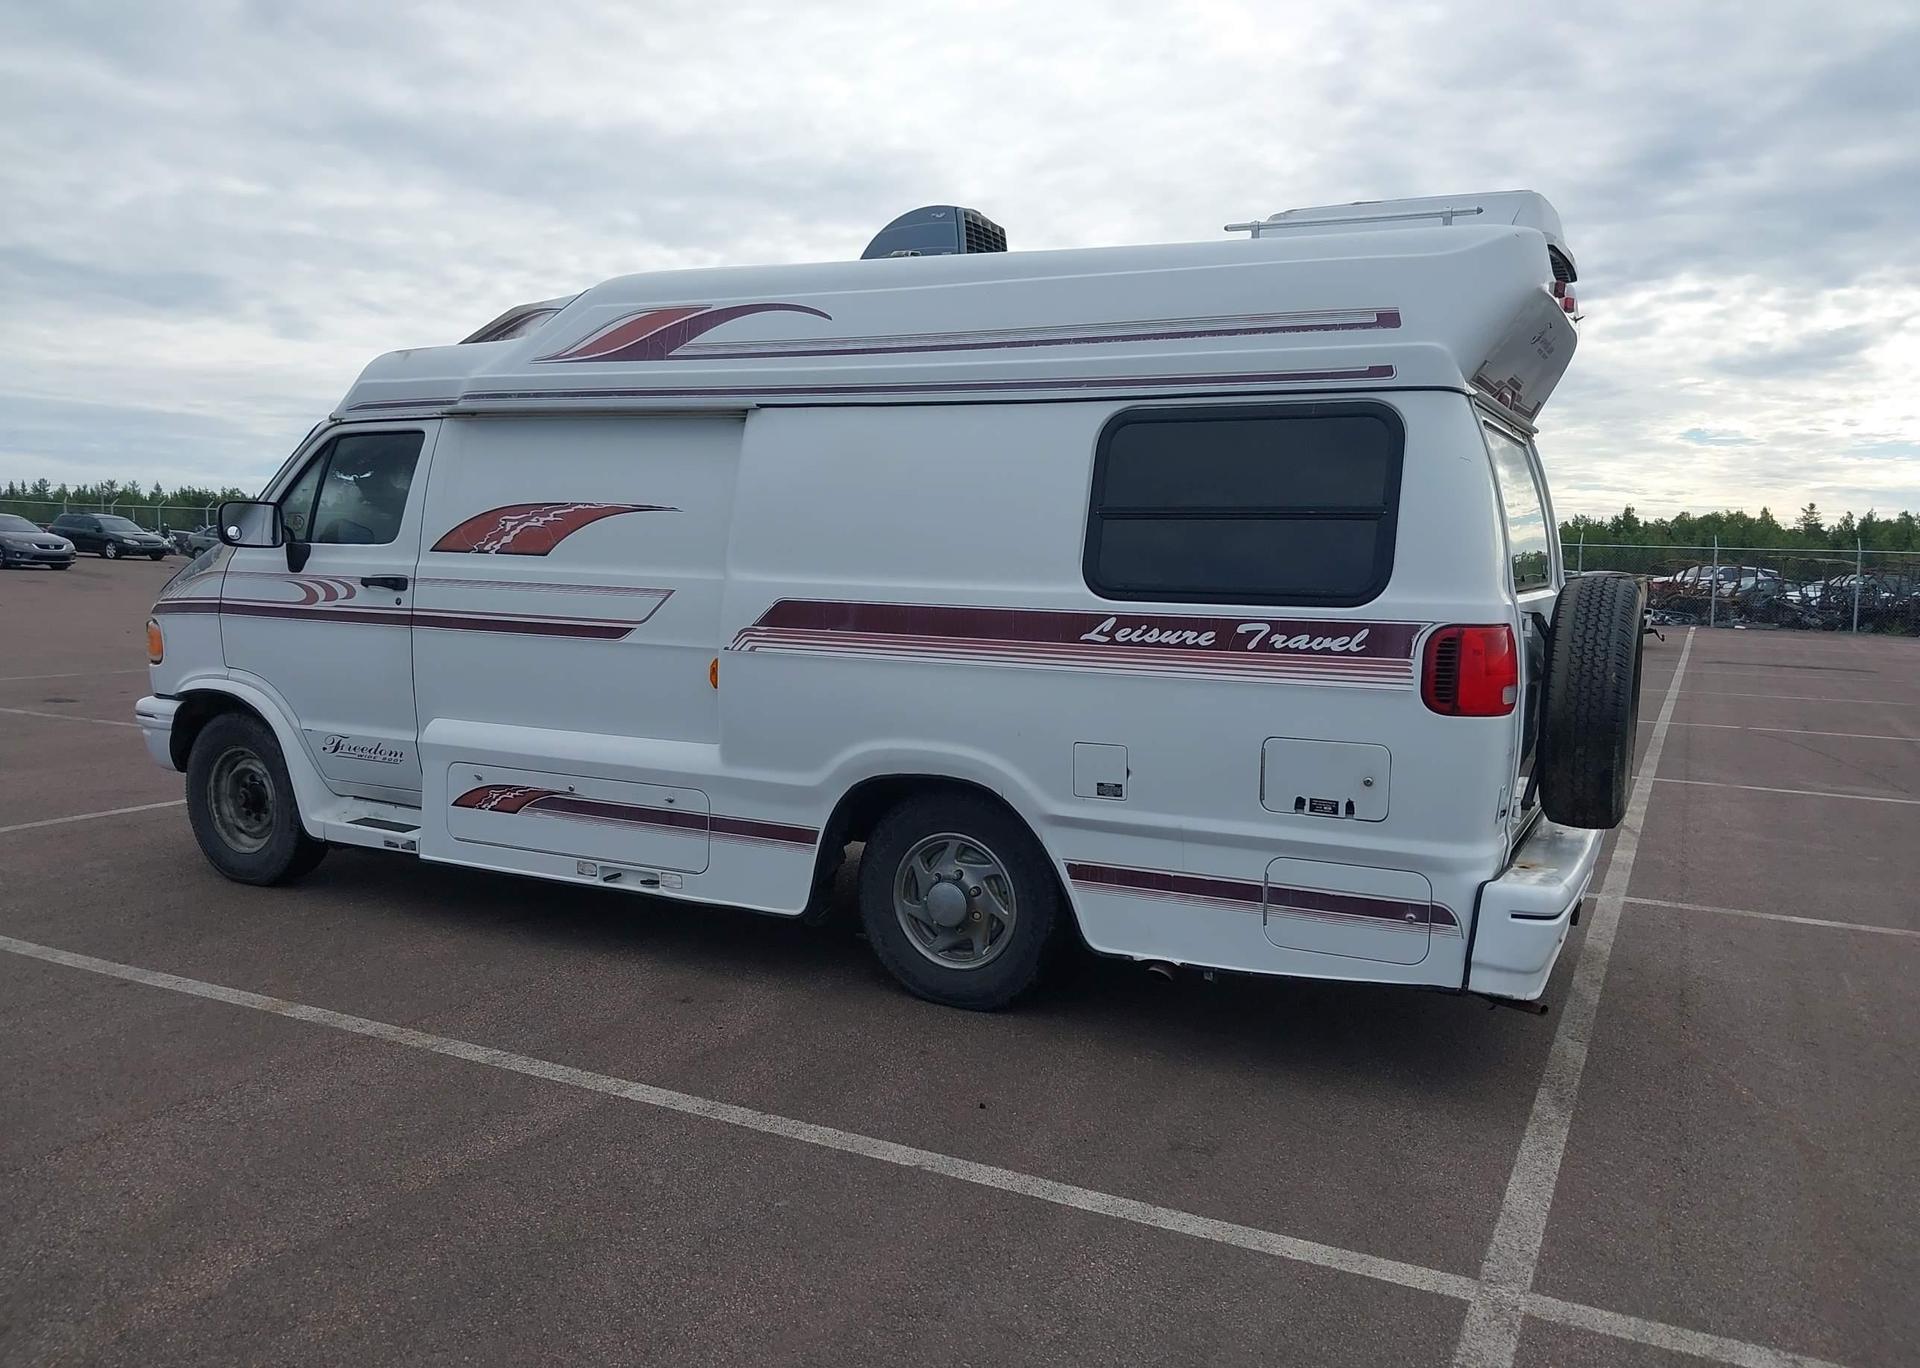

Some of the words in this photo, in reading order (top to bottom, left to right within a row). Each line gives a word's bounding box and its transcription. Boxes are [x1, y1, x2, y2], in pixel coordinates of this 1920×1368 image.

[1080, 616, 1216, 647] Leisure
[1236, 622, 1370, 652] Travel
[322, 734, 404, 758] Freedom
